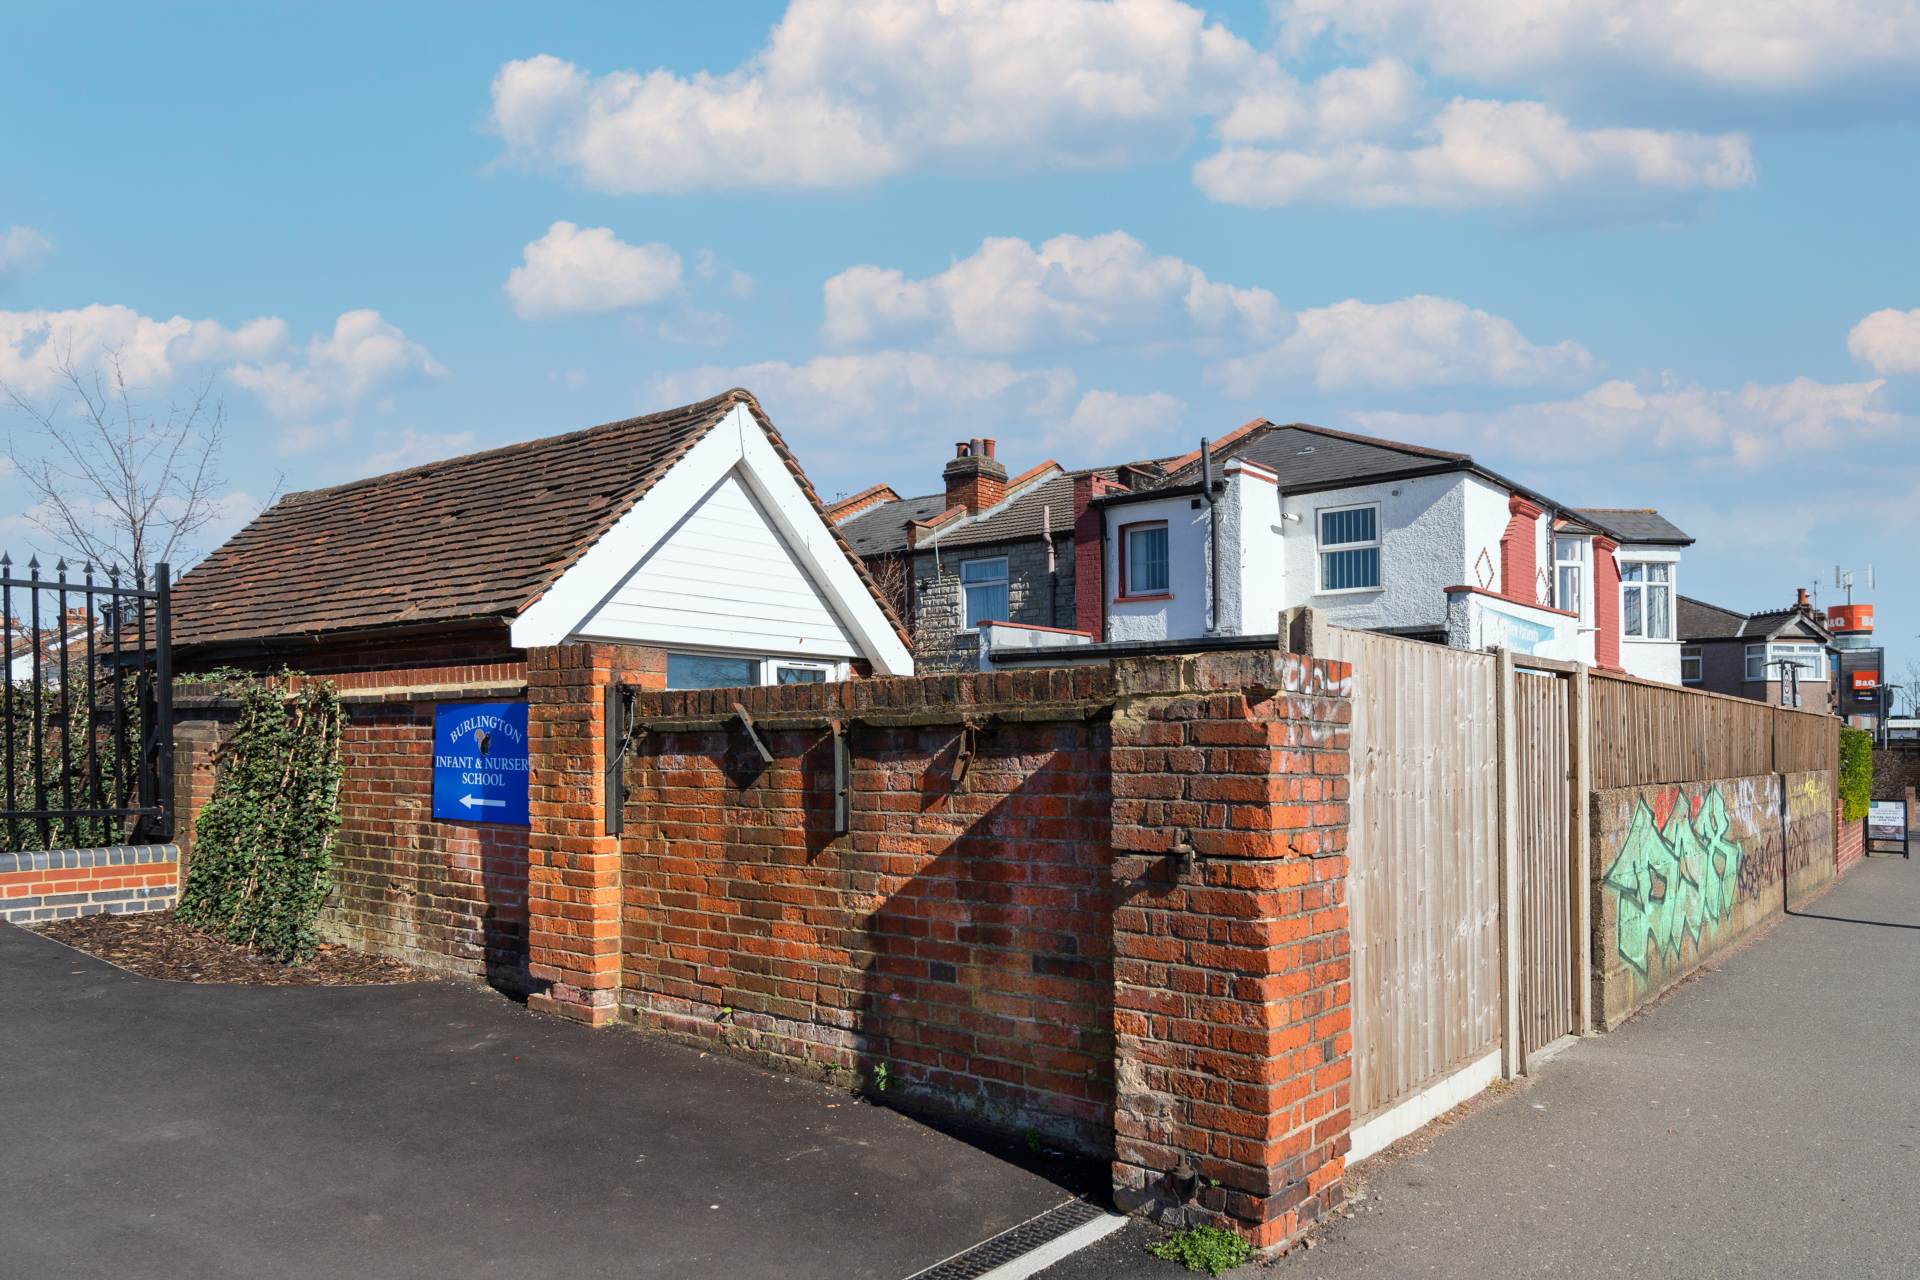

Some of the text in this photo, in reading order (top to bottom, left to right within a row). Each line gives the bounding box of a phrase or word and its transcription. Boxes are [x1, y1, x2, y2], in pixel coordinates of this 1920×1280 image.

[450, 716, 522, 744] BURLINGTON
[436, 756, 529, 771] INFANT & NURSER
[462, 772, 506, 786] SCHOOL
